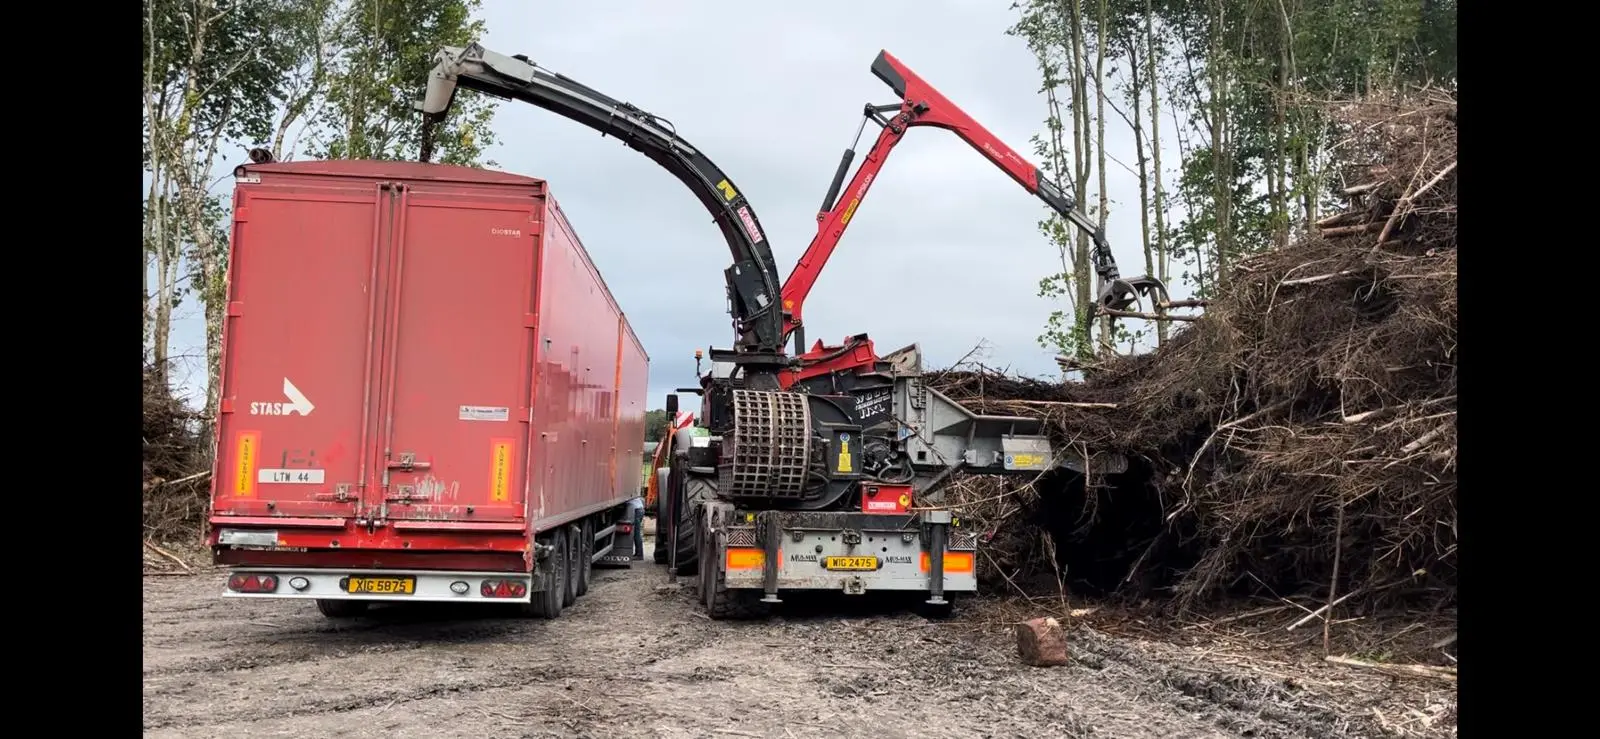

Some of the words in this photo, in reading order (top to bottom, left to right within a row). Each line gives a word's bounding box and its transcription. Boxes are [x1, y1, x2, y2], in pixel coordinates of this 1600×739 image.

[250, 401, 282, 415] STAS
[298, 471, 309, 482] 44
[832, 558, 846, 567] WIG
[849, 558, 872, 567] 2475
[356, 580, 374, 592] XIG
[377, 580, 406, 592] 5875
